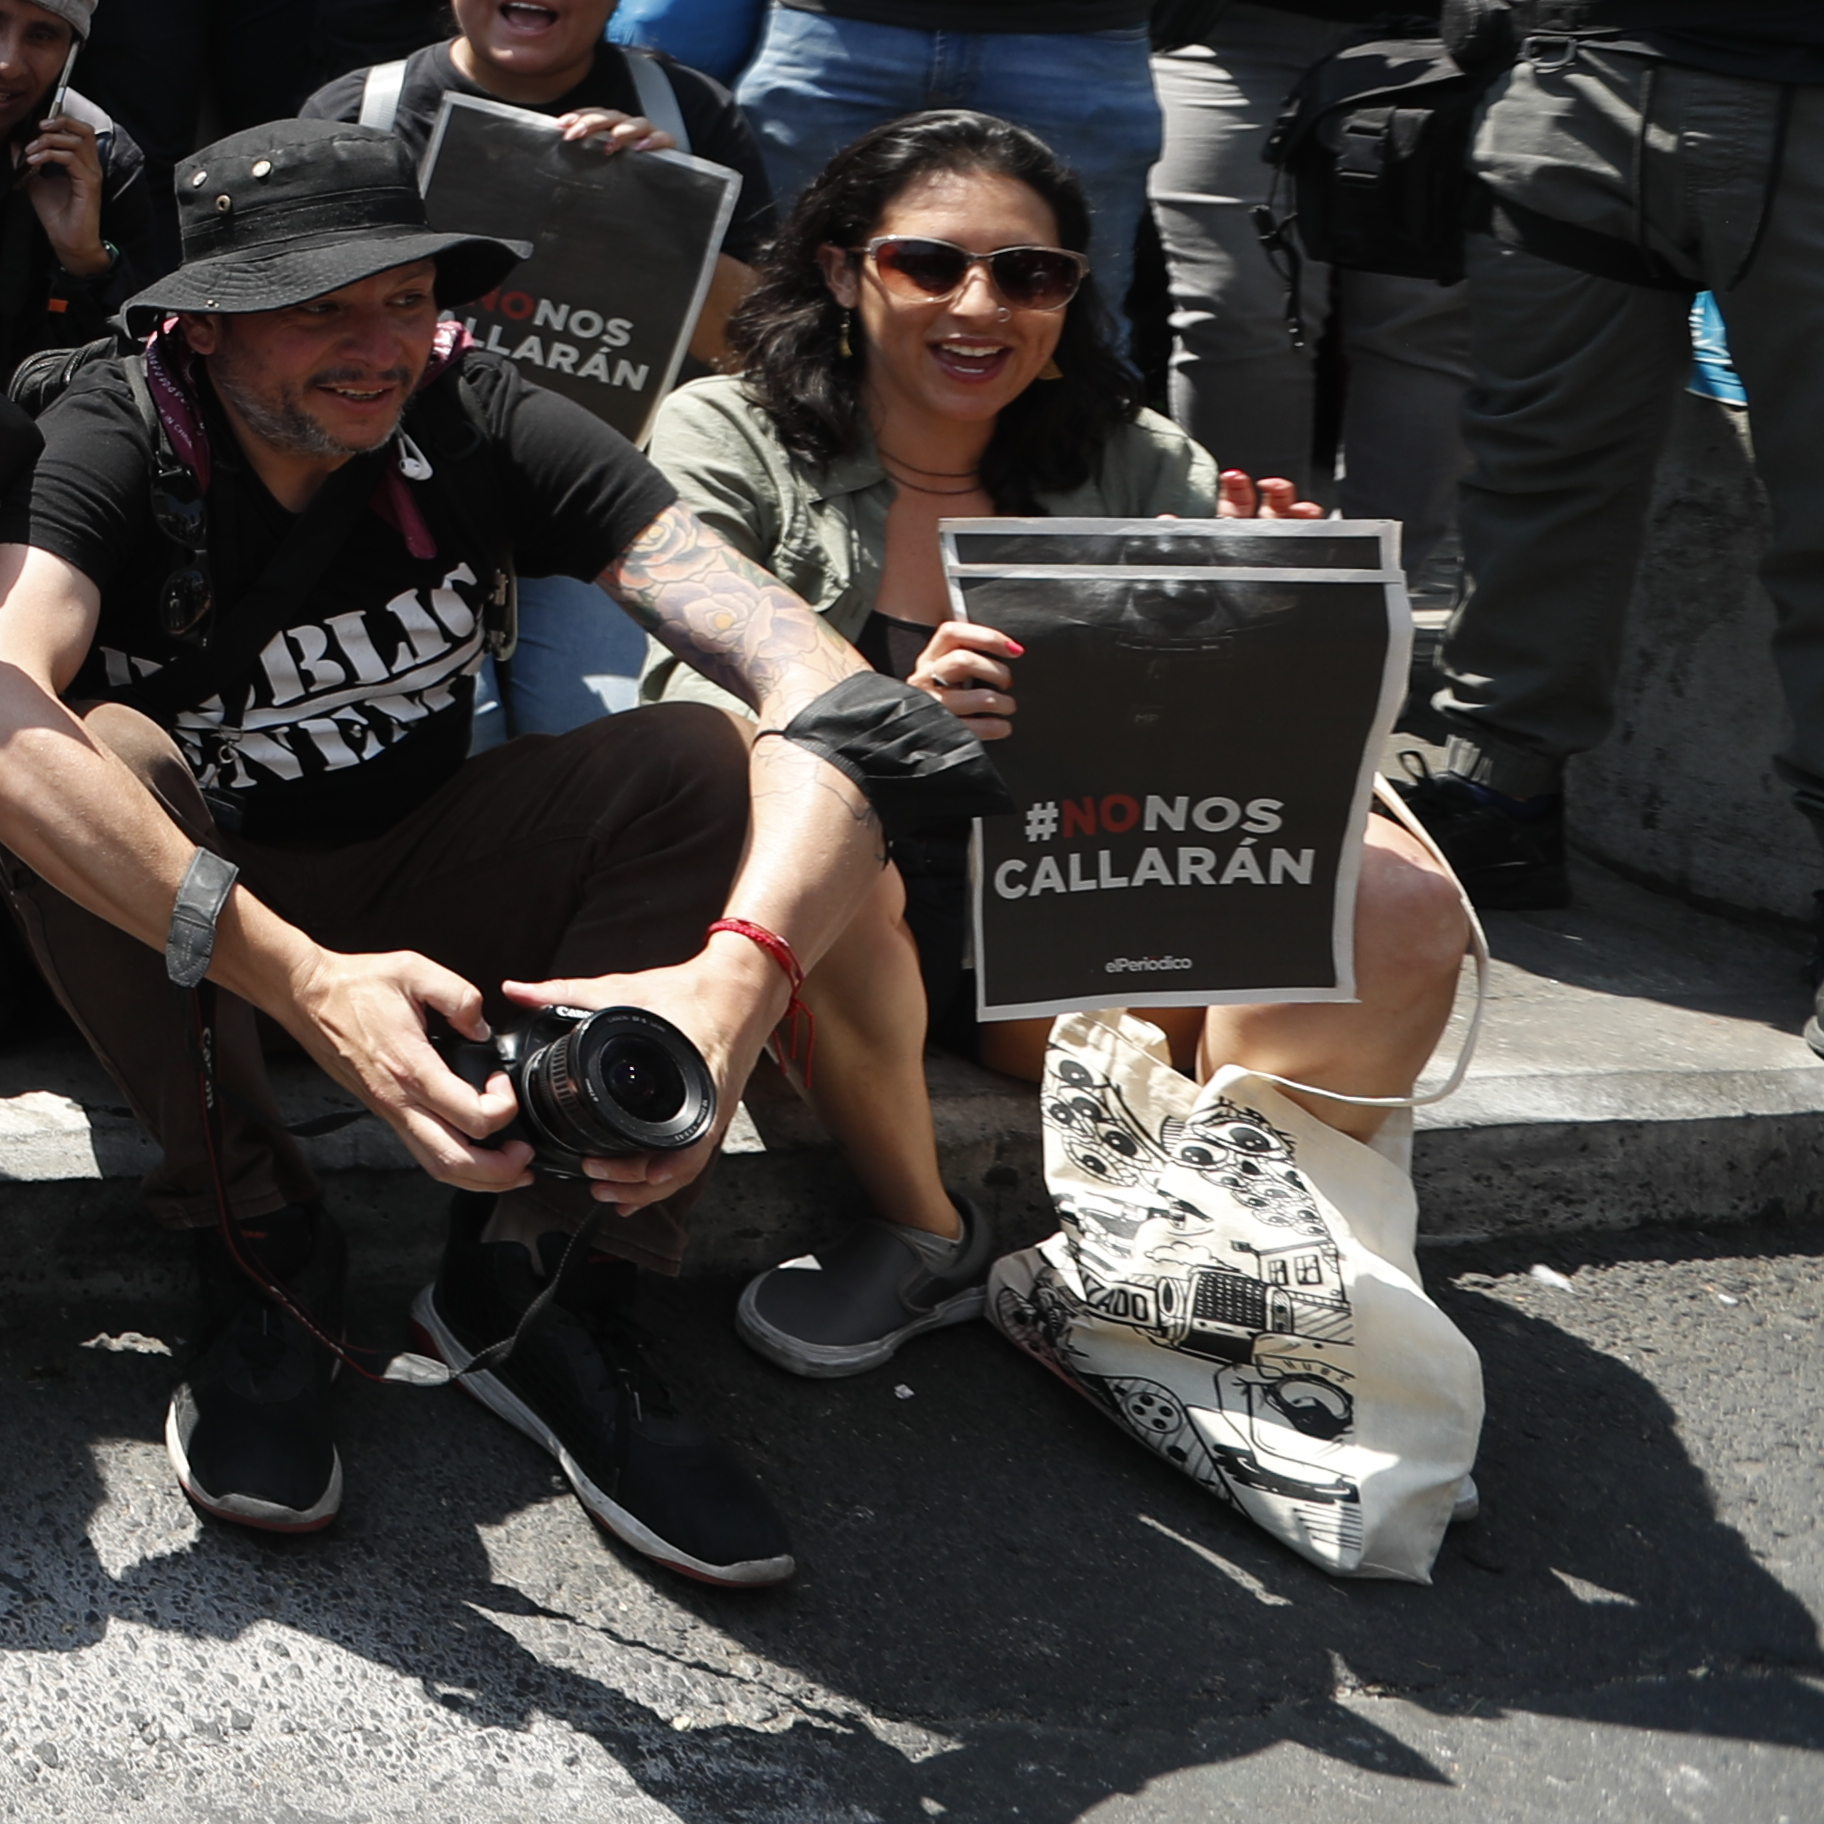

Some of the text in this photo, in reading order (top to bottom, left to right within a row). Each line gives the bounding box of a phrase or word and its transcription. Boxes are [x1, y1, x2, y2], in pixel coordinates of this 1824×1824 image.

[1025, 795, 1284, 841] #NONOS
[994, 838, 1315, 899] CALLARÁN
[1105, 957, 1192, 973] elPeriodico
